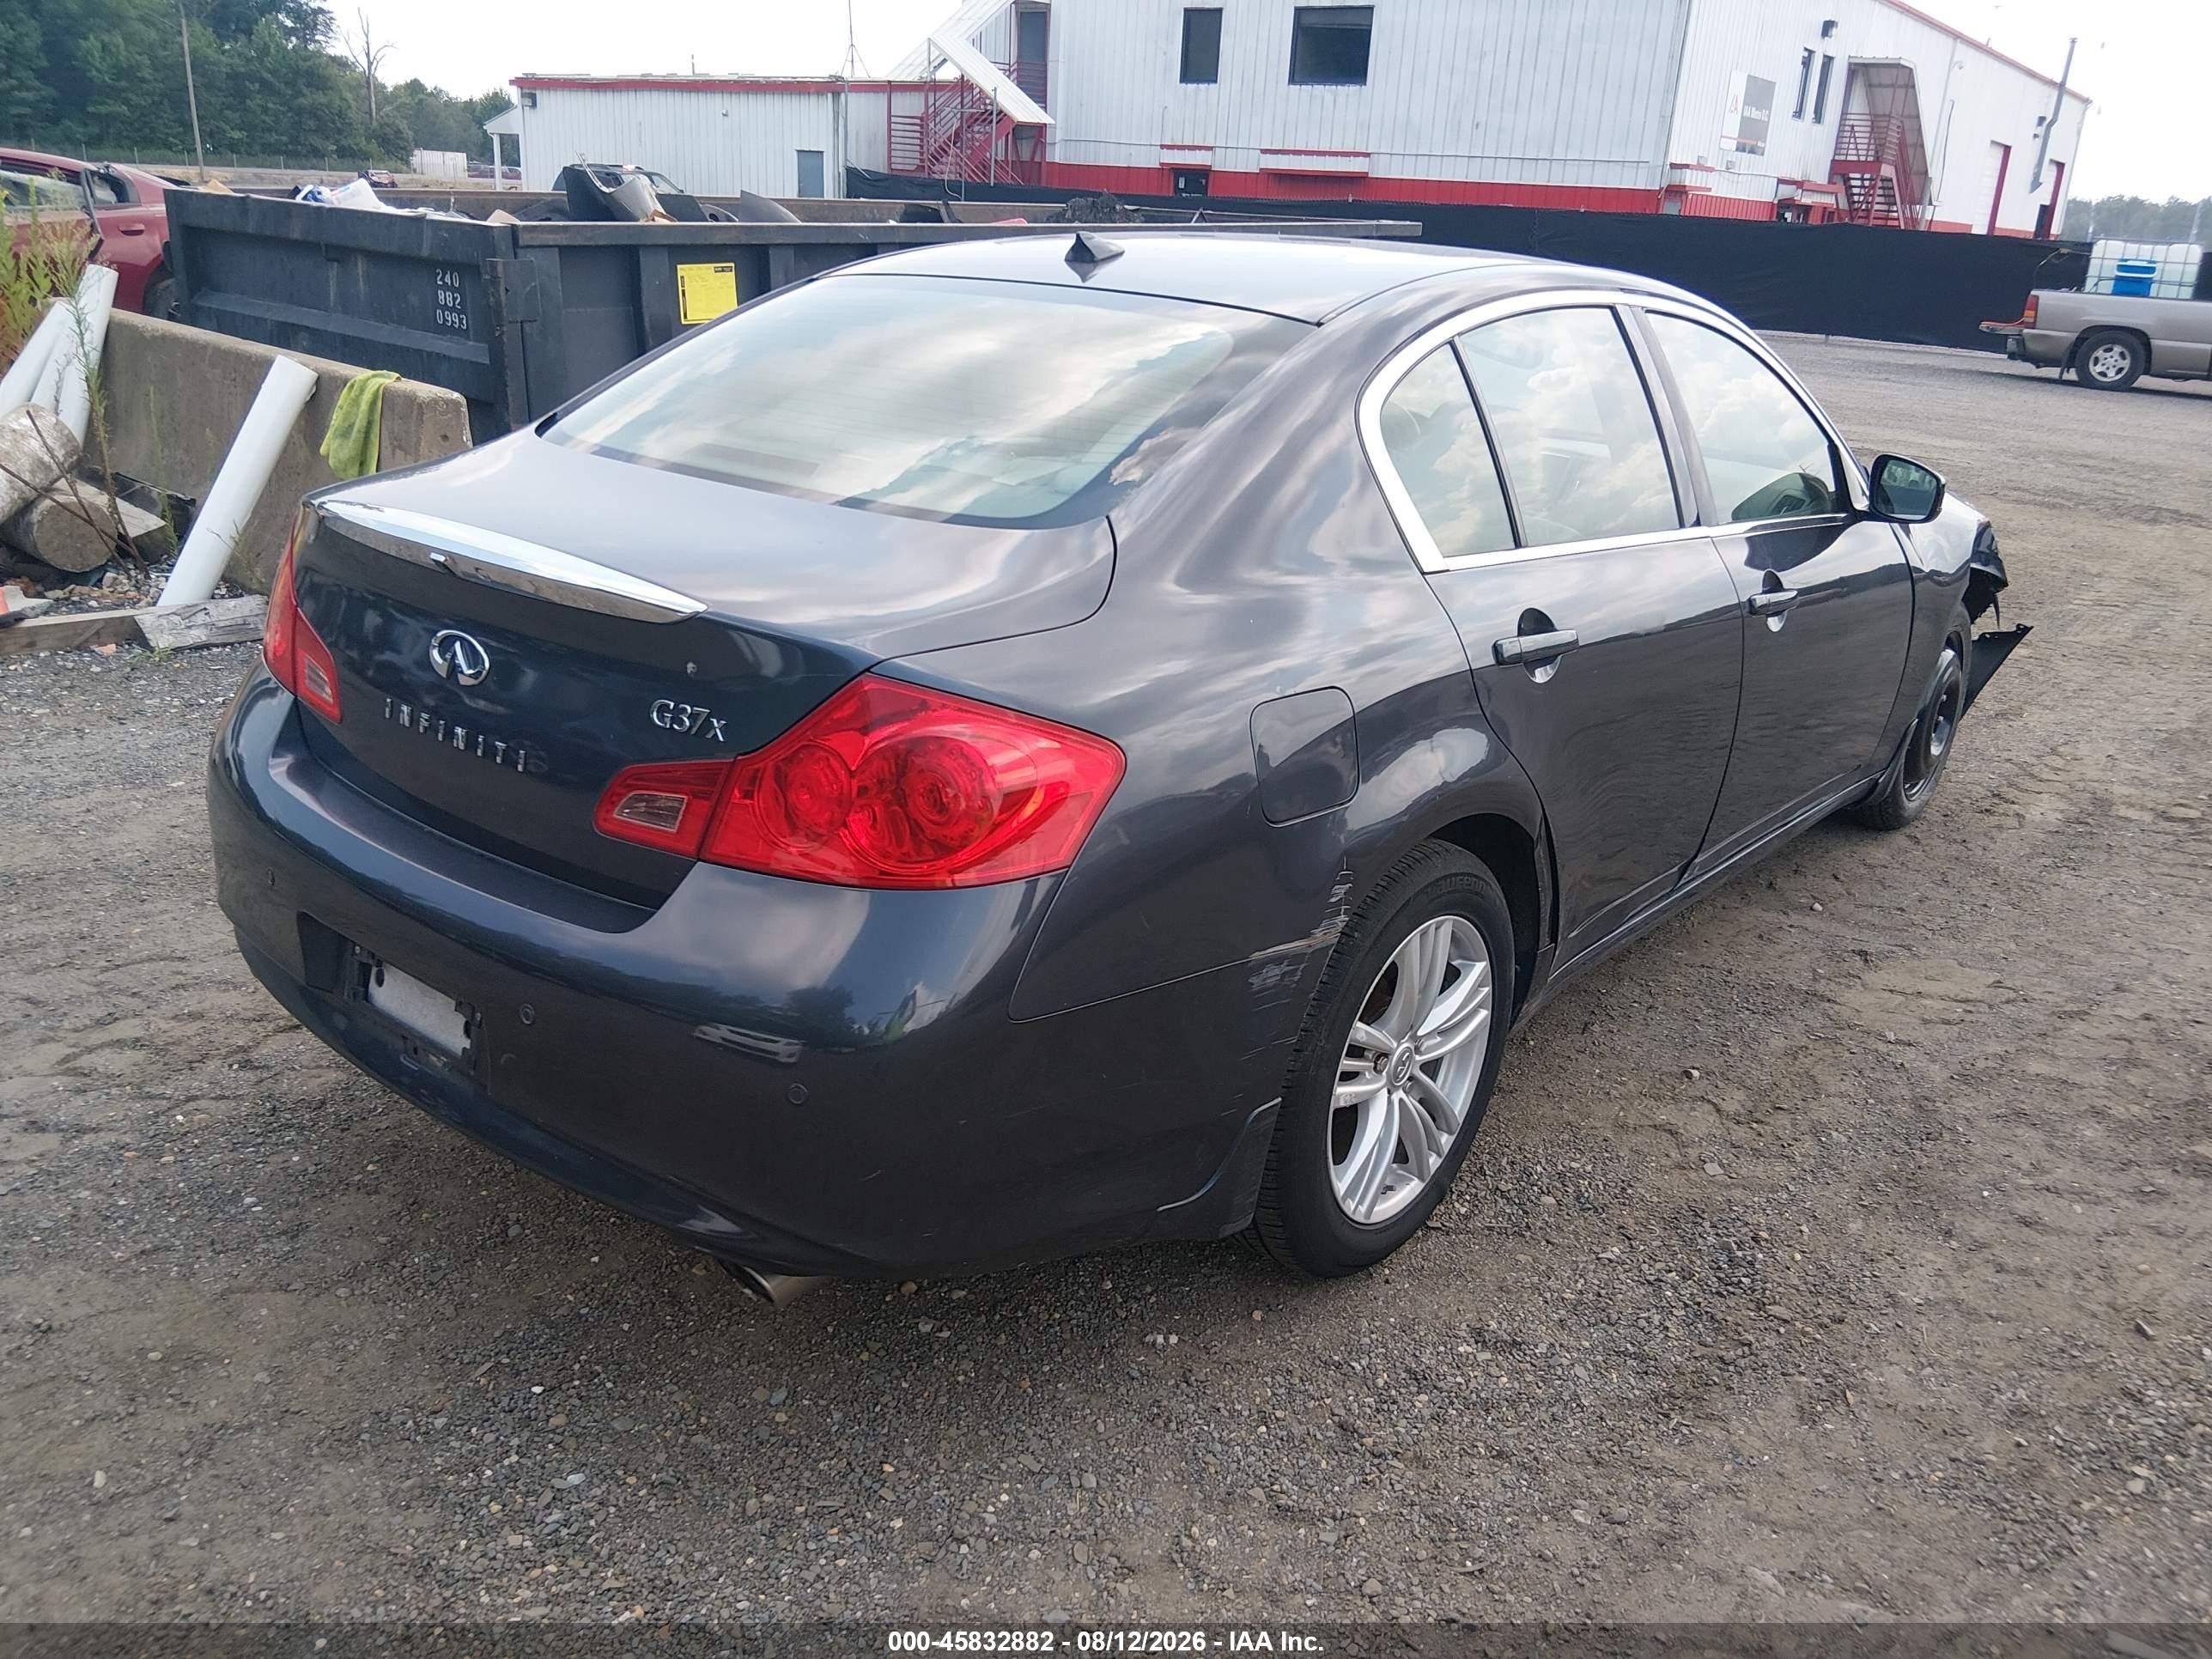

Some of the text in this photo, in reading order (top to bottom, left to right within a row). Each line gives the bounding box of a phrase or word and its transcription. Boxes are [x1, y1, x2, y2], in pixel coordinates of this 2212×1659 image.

[436, 269, 459, 288] 240
[438, 289, 461, 308] 882
[436, 309, 467, 330] 0993
[385, 697, 526, 772] INFINITI
